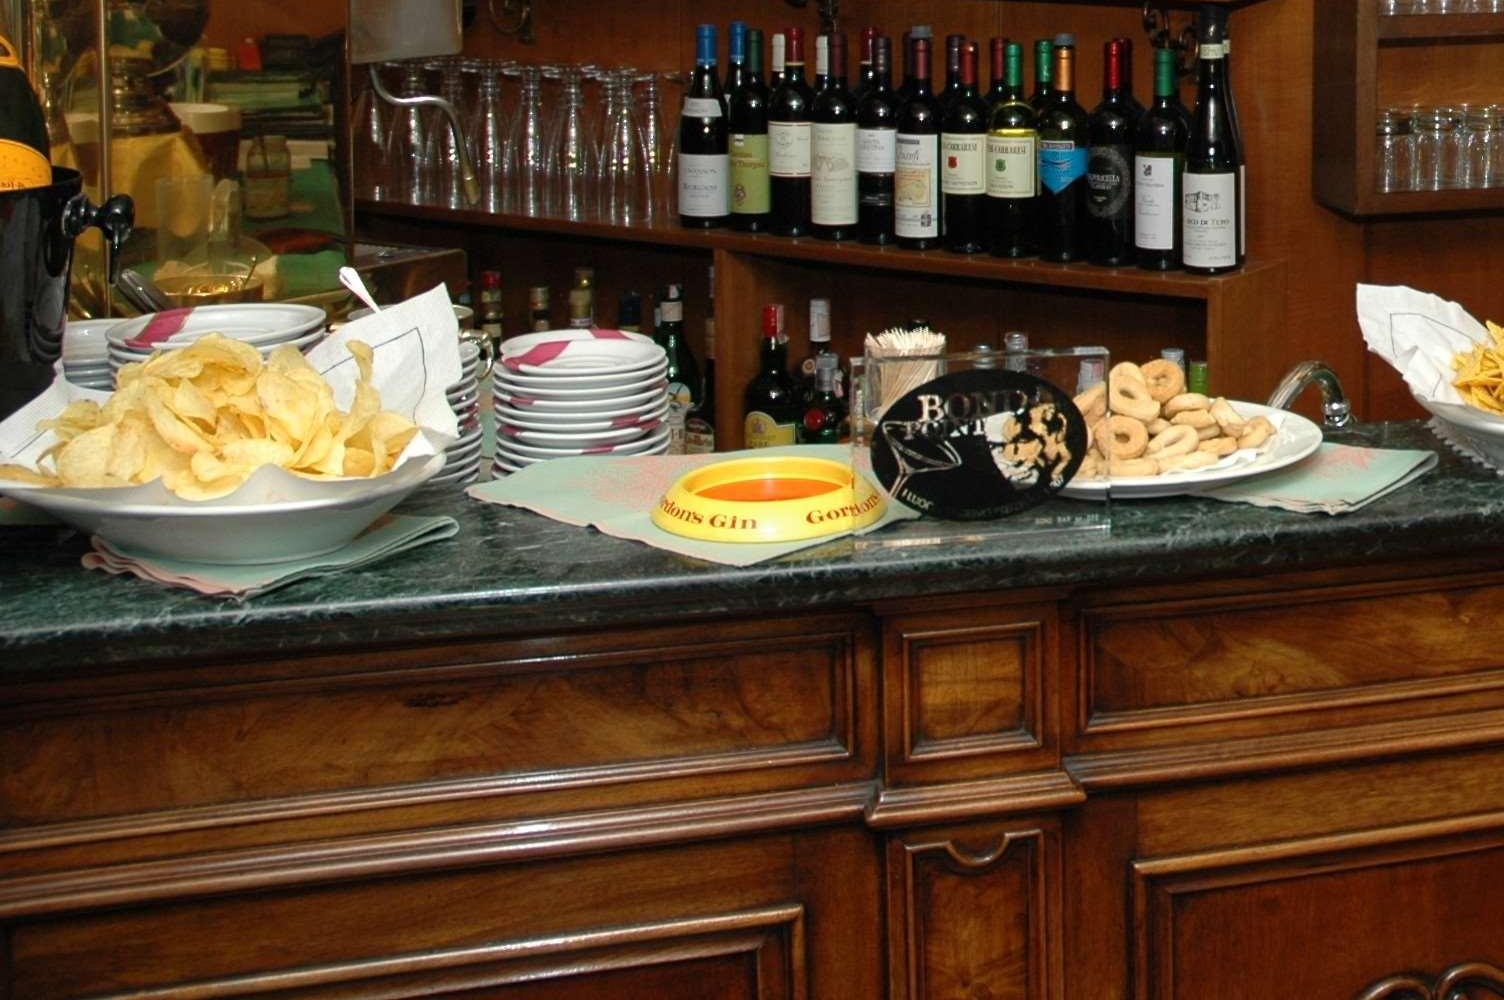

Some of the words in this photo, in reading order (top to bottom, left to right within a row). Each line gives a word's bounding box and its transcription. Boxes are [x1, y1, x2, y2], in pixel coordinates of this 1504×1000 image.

[917, 389, 1029, 423] BOND
[904, 417, 987, 441] POINT
[708, 514, 759, 531] Gin
